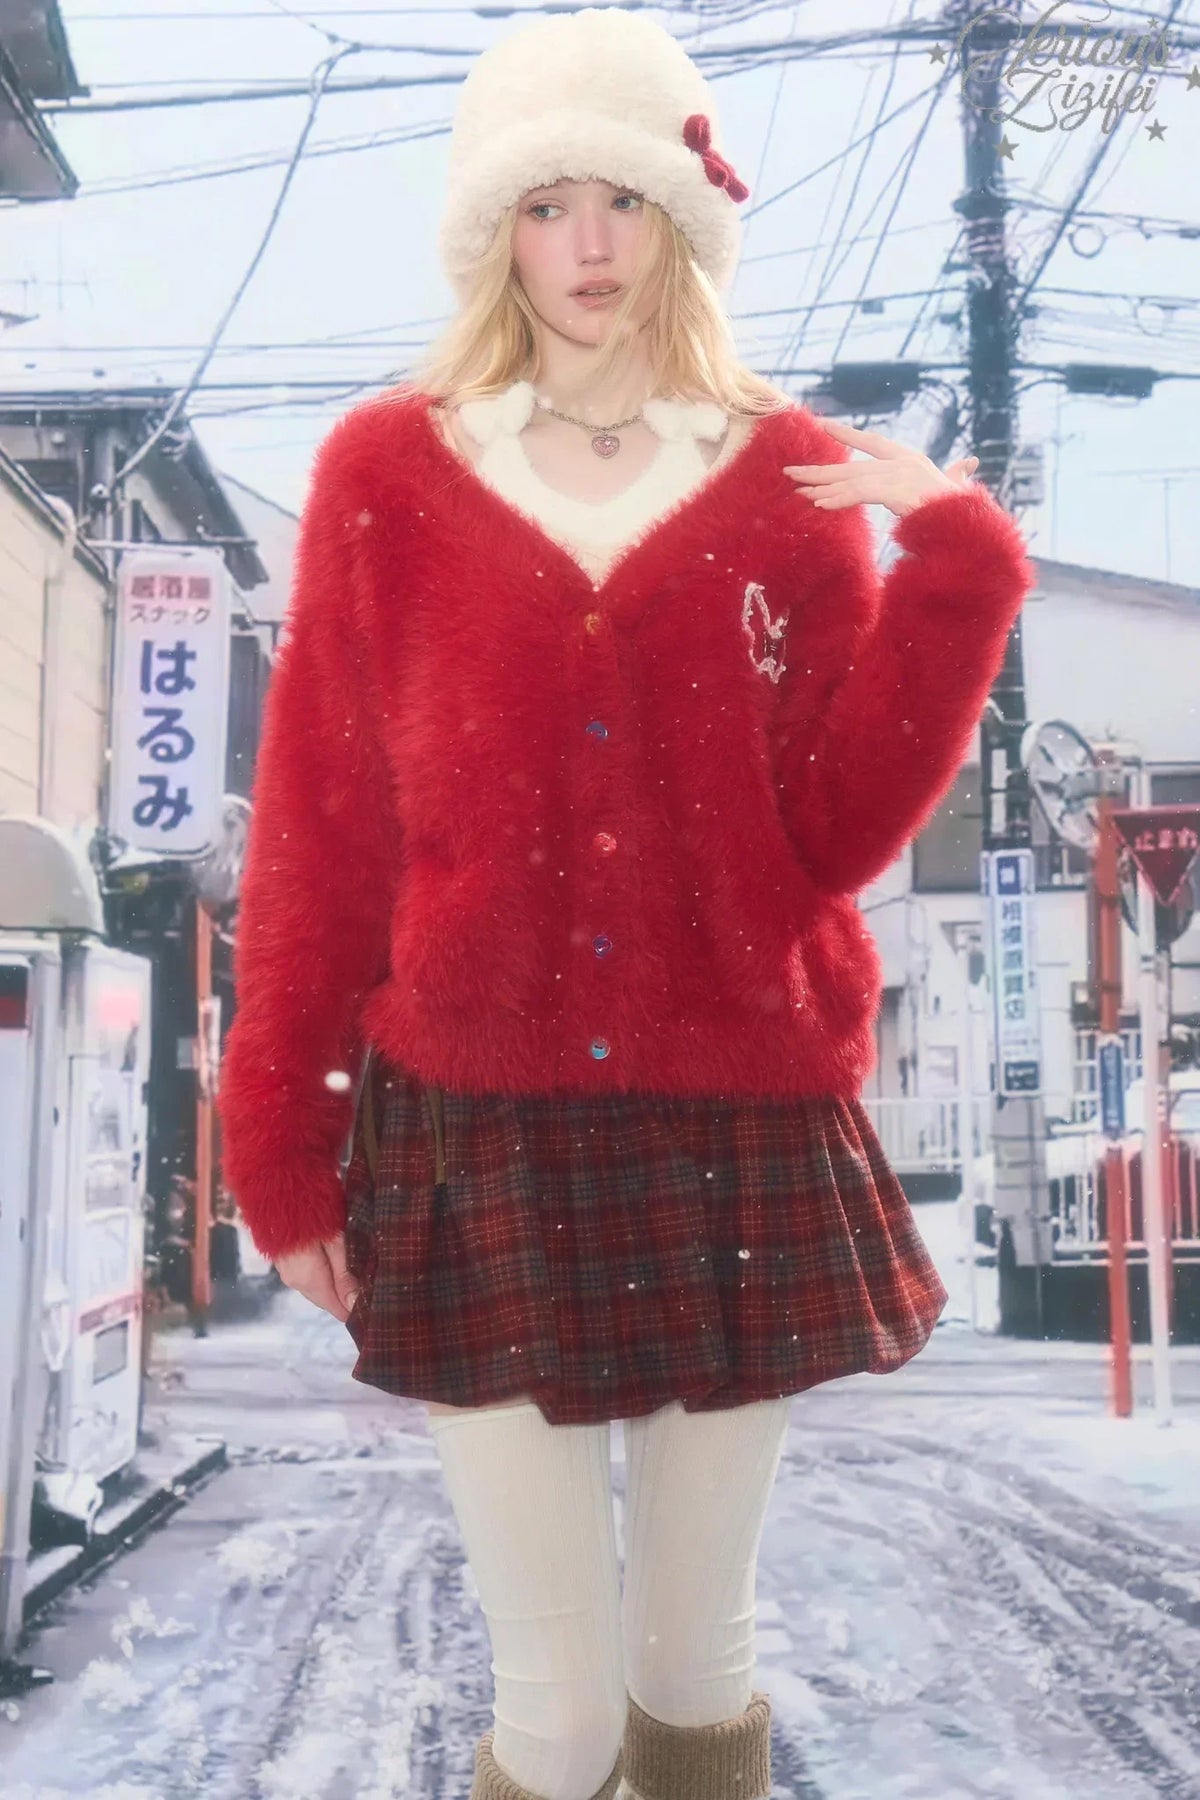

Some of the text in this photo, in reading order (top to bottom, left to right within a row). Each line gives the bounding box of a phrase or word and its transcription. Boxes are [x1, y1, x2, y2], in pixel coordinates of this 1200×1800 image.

[130, 603, 211, 625] スナック
[132, 639, 197, 833] はるみ
